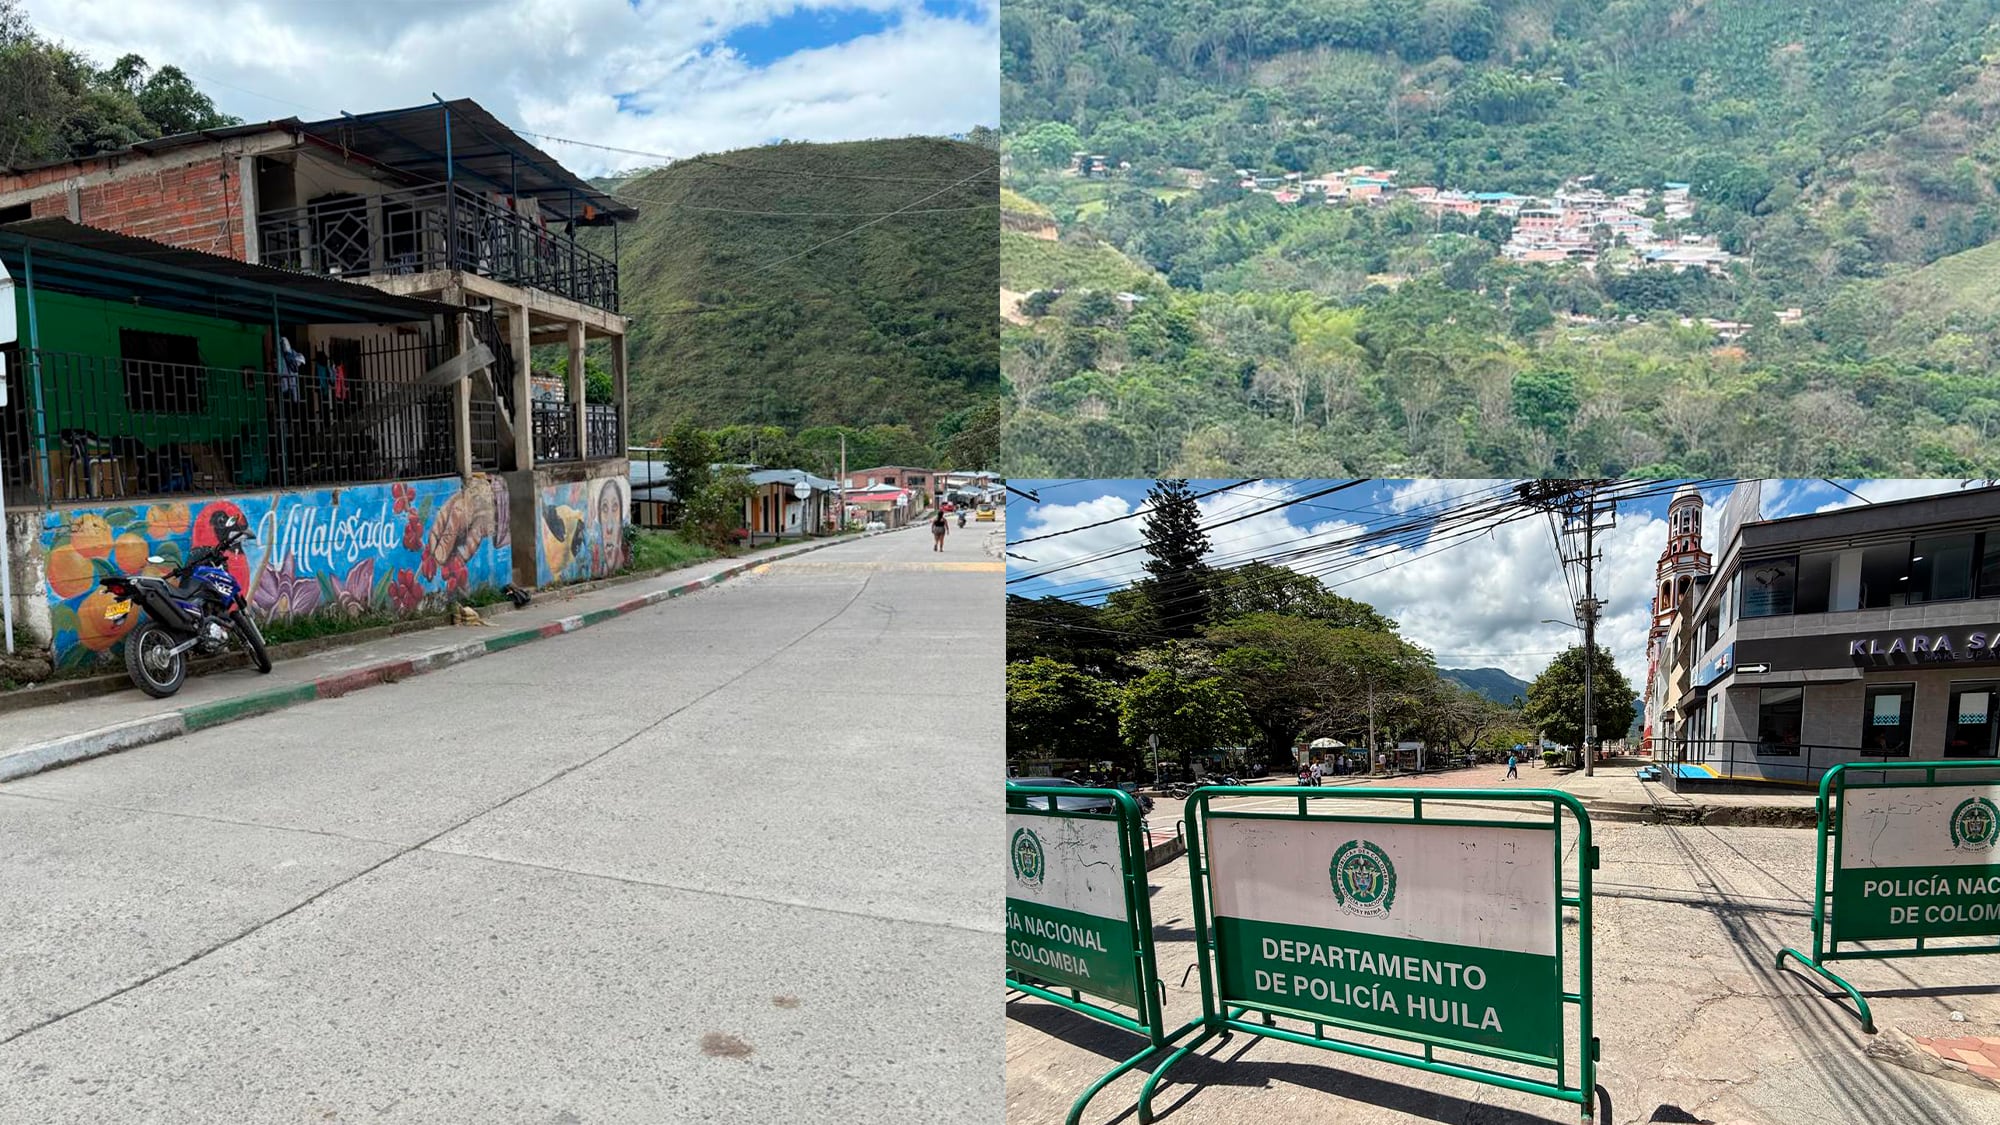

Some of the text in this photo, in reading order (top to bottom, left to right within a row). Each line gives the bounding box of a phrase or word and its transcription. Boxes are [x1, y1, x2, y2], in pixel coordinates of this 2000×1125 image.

[256, 501, 401, 573] Villalosada
[1850, 634, 1952, 655] KLARA
[1925, 651, 1960, 661] MAKE
[1966, 649, 1983, 660] UP
[1370, 853, 1389, 886] COLOMBIA
[1864, 874, 2000, 898] POLICÍA NAC
[1347, 904, 1359, 914] DIOS
[1364, 907, 1382, 916] PATRIA
[1890, 904, 2000, 925] DE COLOM
[1024, 915, 1107, 953] NACIONAL
[1011, 939, 1090, 978] COLOMBIA
[1262, 937, 1486, 990] DEPARTAMENTO
[1255, 969, 1503, 1033] DE POLICÍA HUILA
